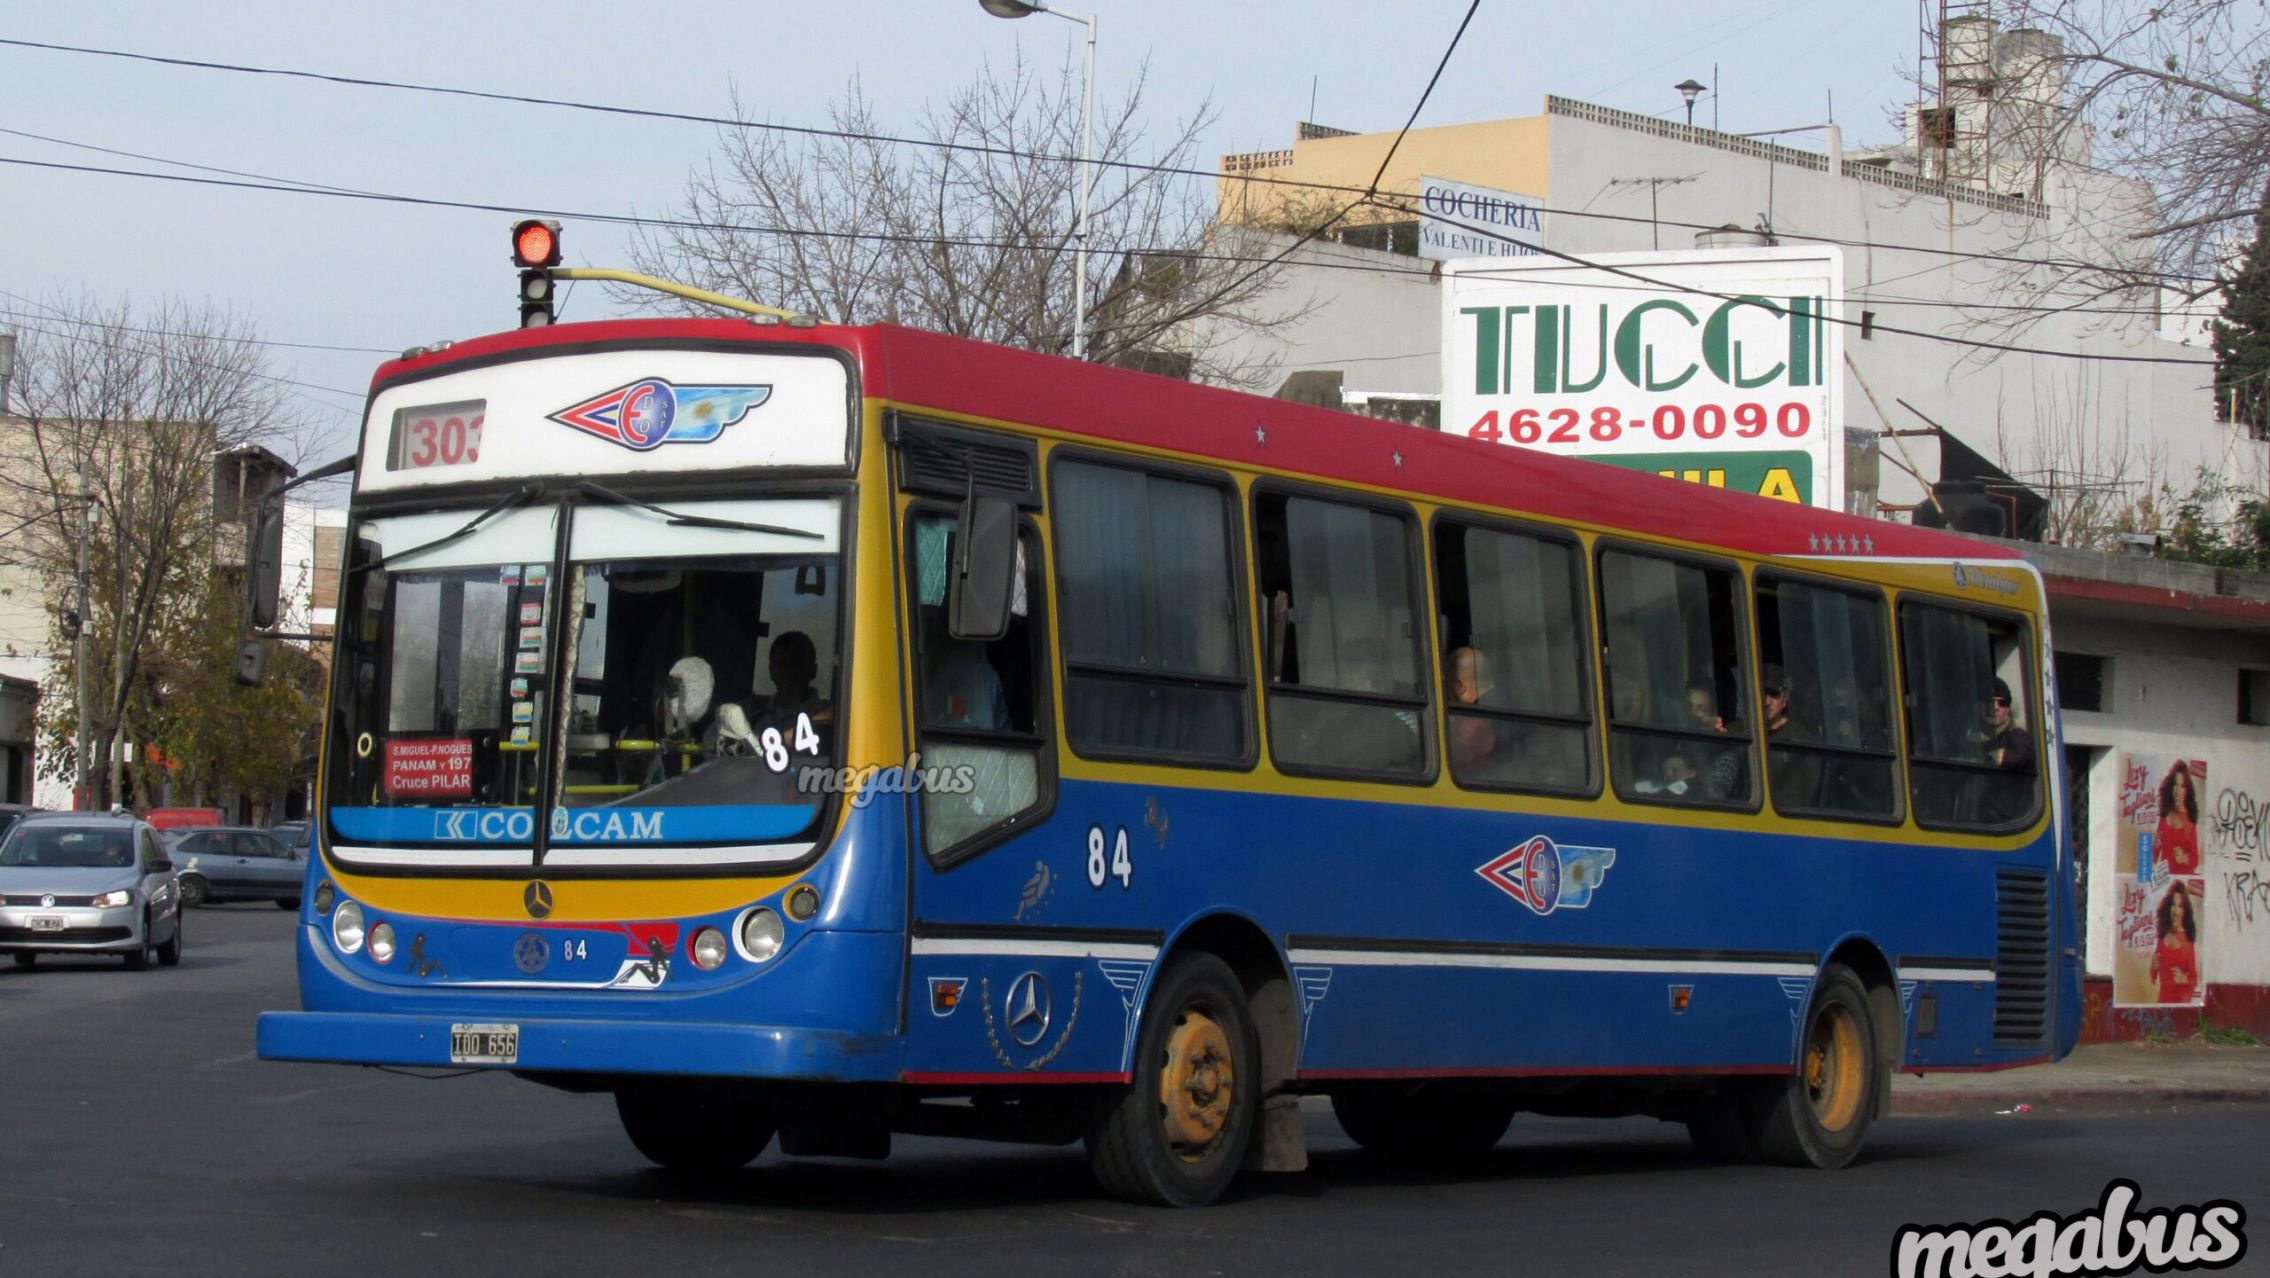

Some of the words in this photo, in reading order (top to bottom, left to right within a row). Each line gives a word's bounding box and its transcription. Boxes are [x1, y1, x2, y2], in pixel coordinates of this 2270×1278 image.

[1425, 185, 1541, 232] COCHERIA
[1422, 227, 1484, 255] VALENTI
[1488, 240, 1498, 257] E
[1501, 243, 1541, 257] HIJO
[1460, 294, 1824, 396] TUCCI
[1468, 402, 1812, 445] 4628-0090
[761, 712, 820, 773] 84
[392, 760, 437, 771] PANAM
[448, 757, 472, 770] 197
[392, 775, 428, 788] Cruce
[432, 774, 471, 788] PILAR
[1088, 827, 1132, 887] 84
[564, 939, 588, 961] 84
[489, 1034, 515, 1056] 656
